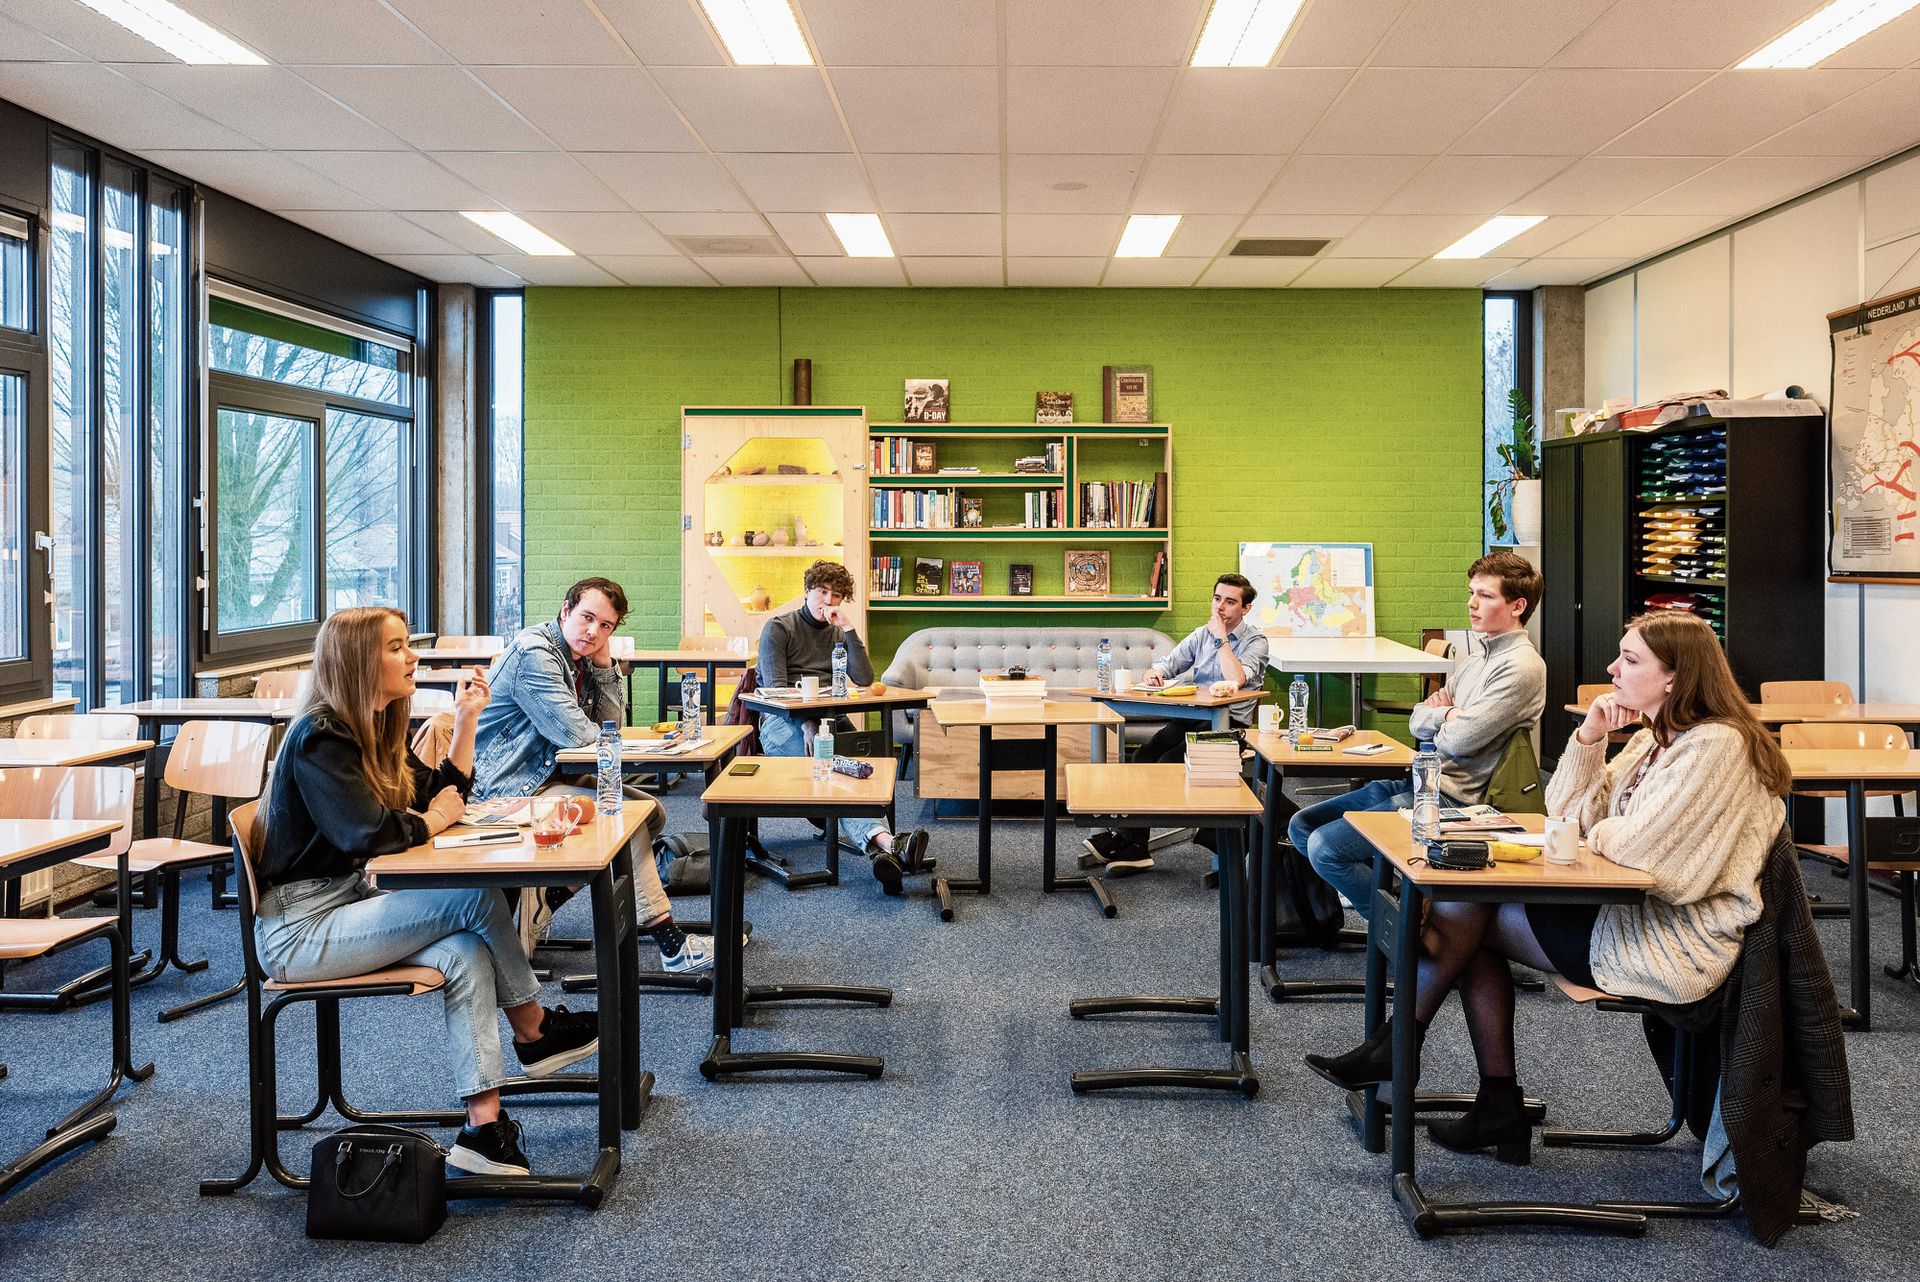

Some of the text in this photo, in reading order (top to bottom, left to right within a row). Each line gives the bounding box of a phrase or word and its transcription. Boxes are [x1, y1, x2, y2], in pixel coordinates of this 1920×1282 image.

[1867, 301, 1906, 319] NEDERLAND
[1908, 298, 1916, 307] IN
[924, 411, 946, 420] D-DAY
